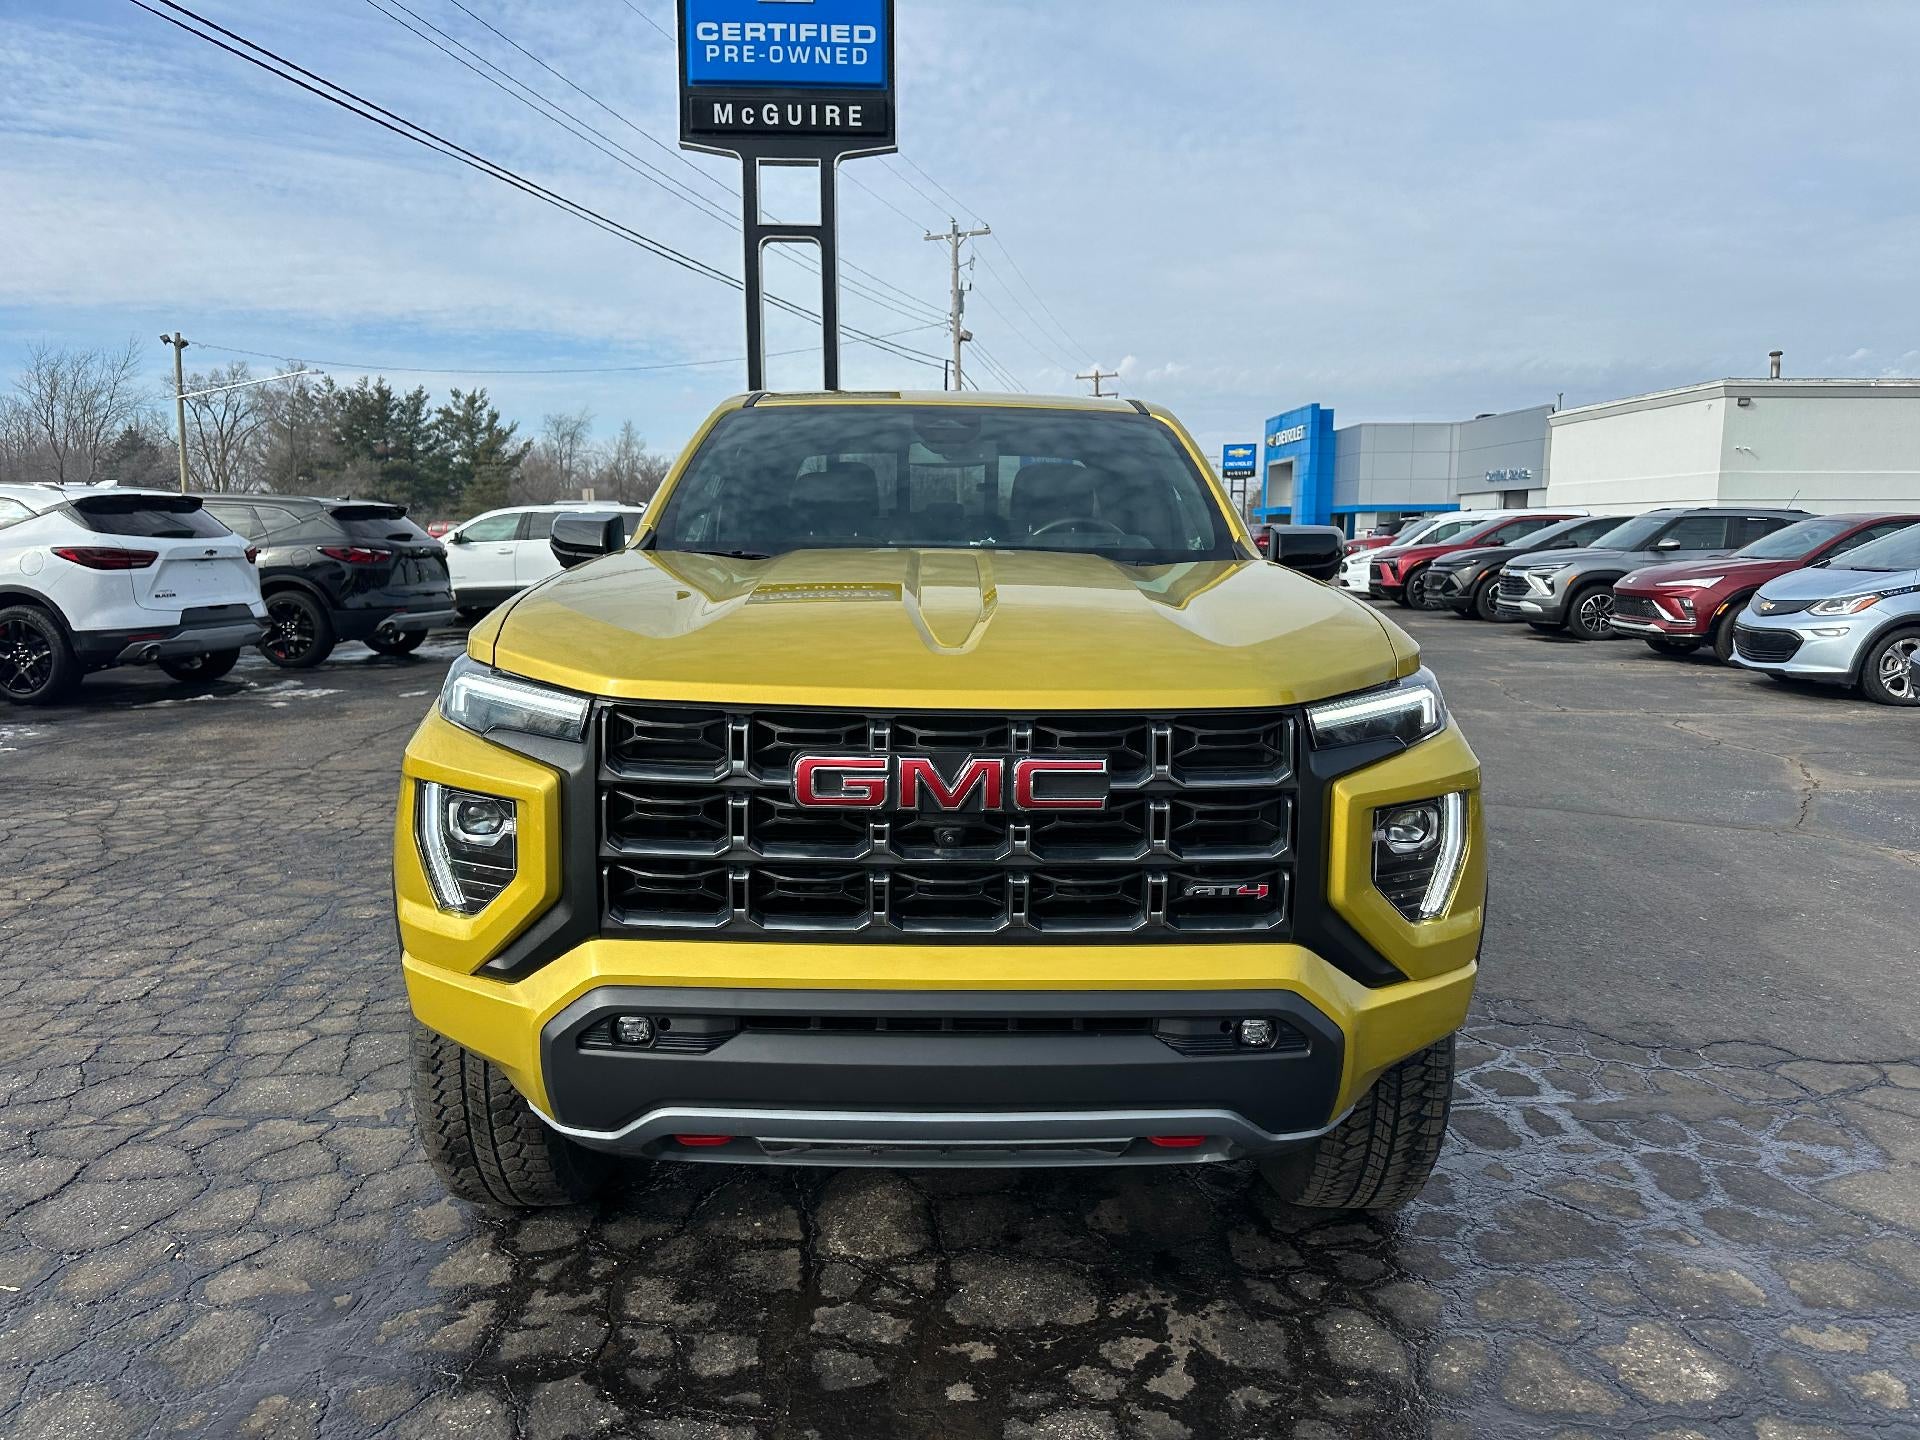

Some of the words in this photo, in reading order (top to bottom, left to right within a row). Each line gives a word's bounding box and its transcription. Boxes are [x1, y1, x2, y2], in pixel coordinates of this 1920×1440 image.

[696, 22, 877, 44] CERTIFIED
[705, 44, 868, 65] PRE-OWNED
[713, 103, 863, 127] McGUIRE
[793, 753, 1108, 812] GMC
[1184, 884, 1269, 900] AT4
